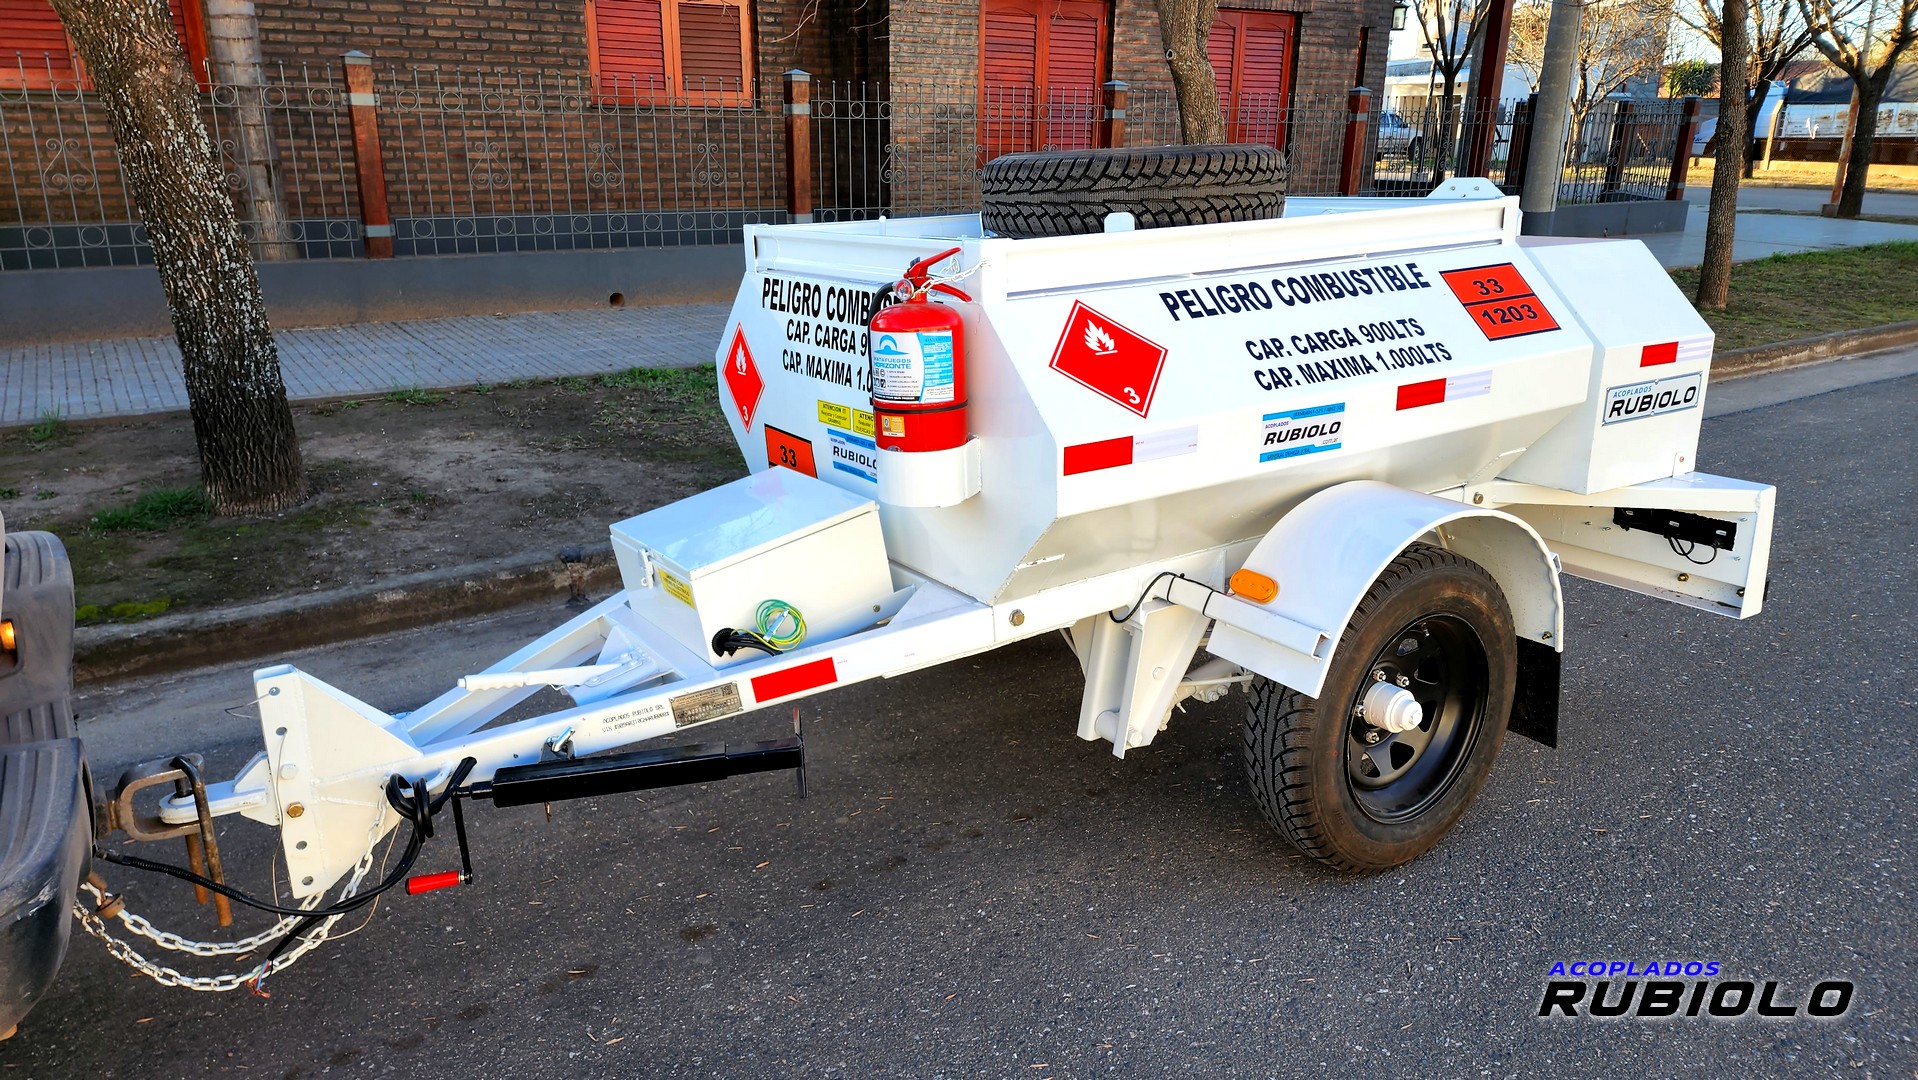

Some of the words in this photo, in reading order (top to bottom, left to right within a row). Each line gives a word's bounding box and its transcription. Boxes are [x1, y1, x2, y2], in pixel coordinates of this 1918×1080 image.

[762, 277, 822, 318] PELIGRO
[1159, 282, 1273, 321] PELIGRO
[1271, 263, 1432, 307] COMBUSTIBLE
[1472, 278, 1504, 296] 33
[1481, 304, 1538, 325] 1203
[786, 318, 811, 344] CAP.
[814, 323, 857, 354] CARGA
[1245, 337, 1293, 361] CAP.
[1290, 327, 1363, 355] CARGA
[1358, 318, 1425, 344] 900LTS
[782, 348, 803, 375] CAP.
[806, 354, 853, 388] MAXIMA
[1254, 366, 1302, 391] CAP.
[1296, 354, 1379, 384] MAXIMA
[1375, 342, 1452, 371] 1.000LTS
[1123, 386, 1141, 405] 3
[1608, 386, 1697, 418] RUBIOLO
[1612, 385, 1653, 398] ACOPLADOS
[742, 405, 749, 422] 3
[1264, 420, 1290, 429] ACOPLADOS
[1263, 421, 1342, 446] RUBIOLO
[779, 444, 797, 468] 33
